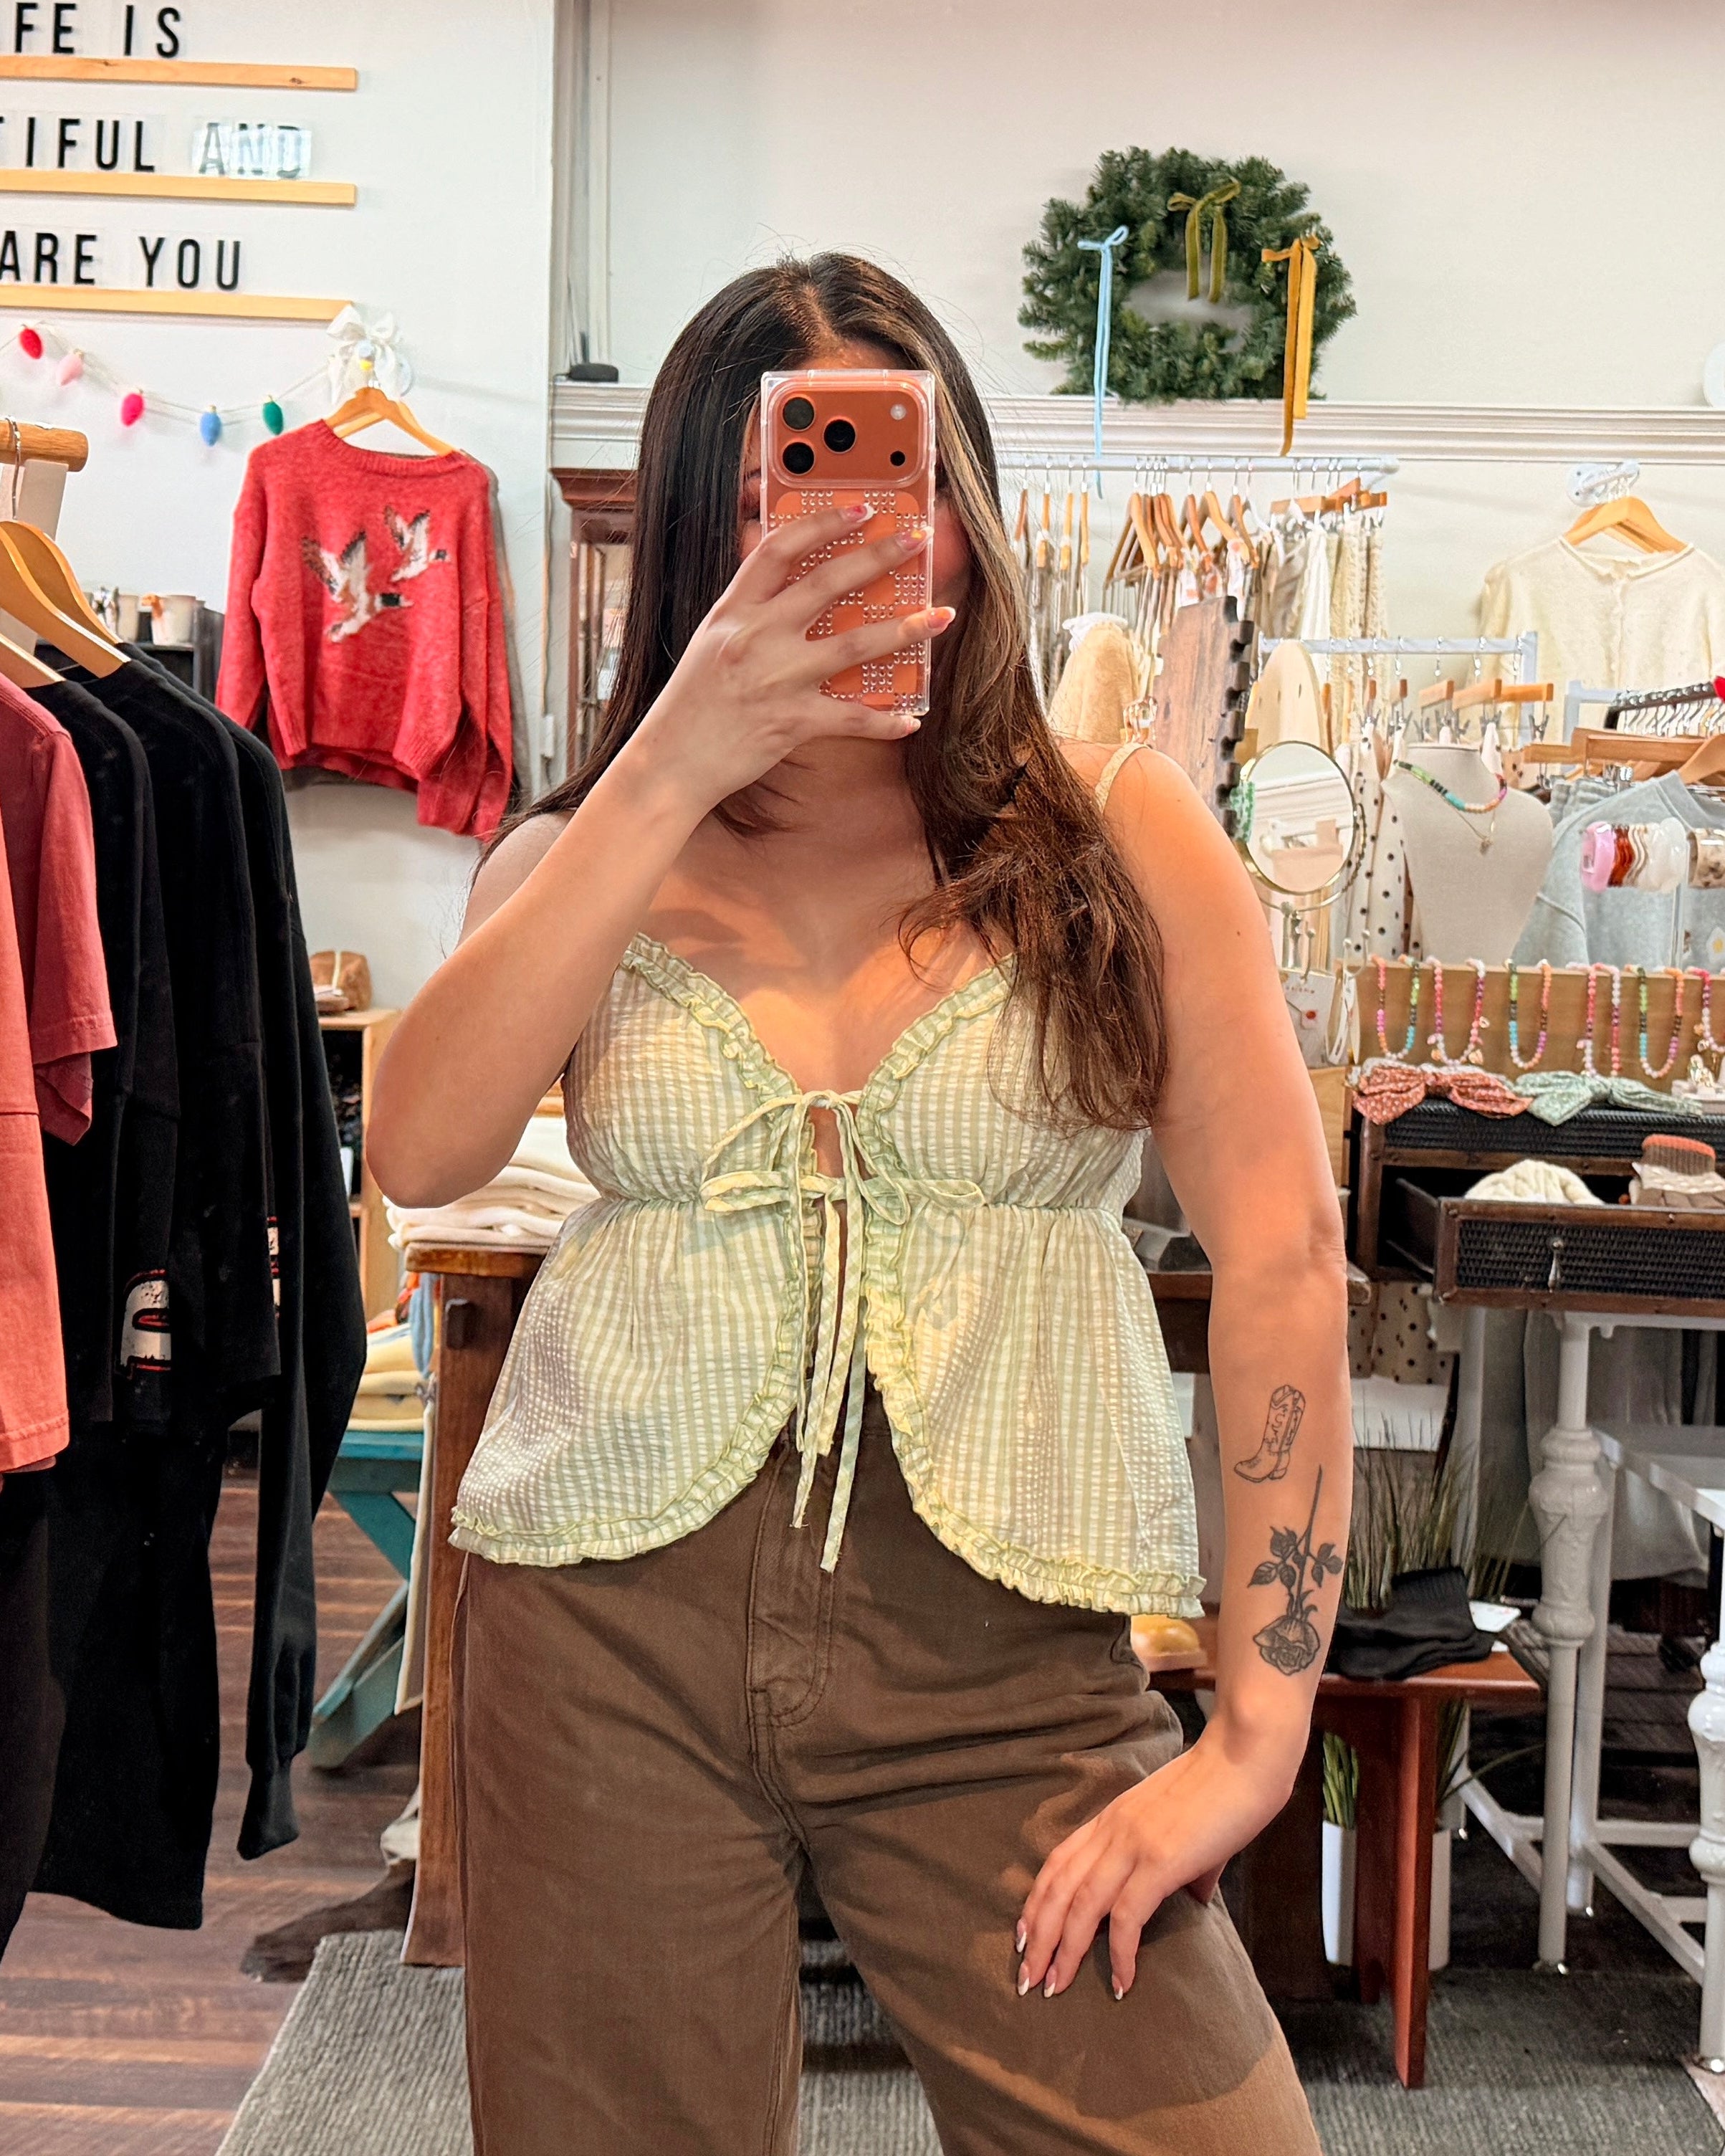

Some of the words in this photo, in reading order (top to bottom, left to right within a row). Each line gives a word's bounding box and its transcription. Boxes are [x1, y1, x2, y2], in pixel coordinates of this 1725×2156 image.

[14, 2, 77, 54] FE
[124, 4, 181, 59] IS
[0, 116, 156, 173] IFUL
[199, 122, 302, 178] AND
[0, 230, 97, 285] ARE
[139, 237, 241, 291] YOU
